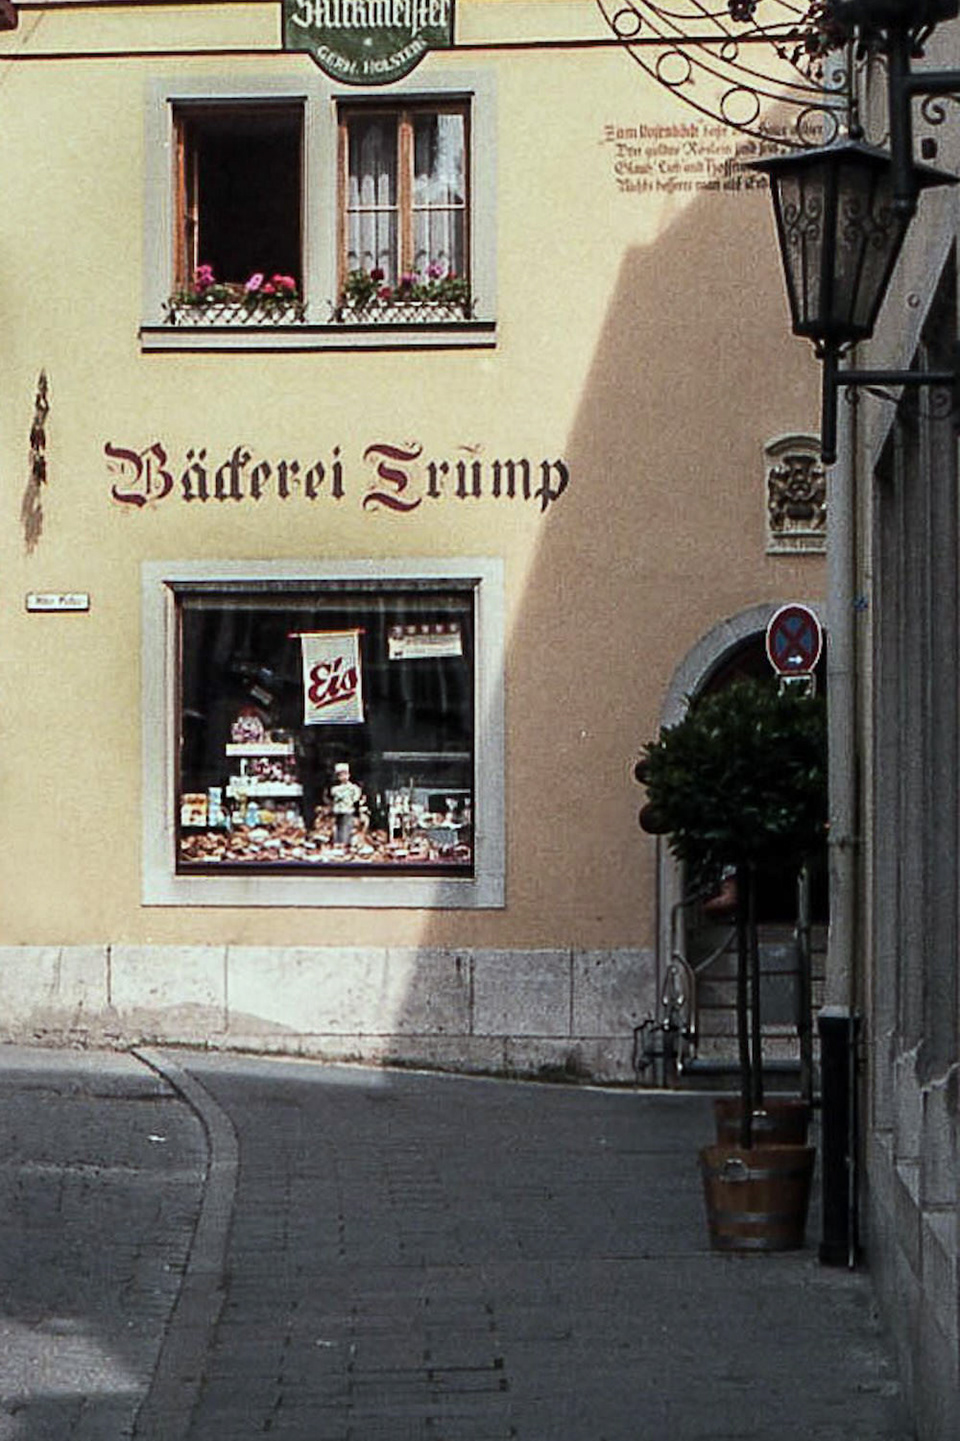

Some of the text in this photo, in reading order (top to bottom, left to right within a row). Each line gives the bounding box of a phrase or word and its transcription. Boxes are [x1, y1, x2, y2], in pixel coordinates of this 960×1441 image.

[104, 441, 570, 513] Bäckerei Trump
[308, 657, 358, 705] Eis
